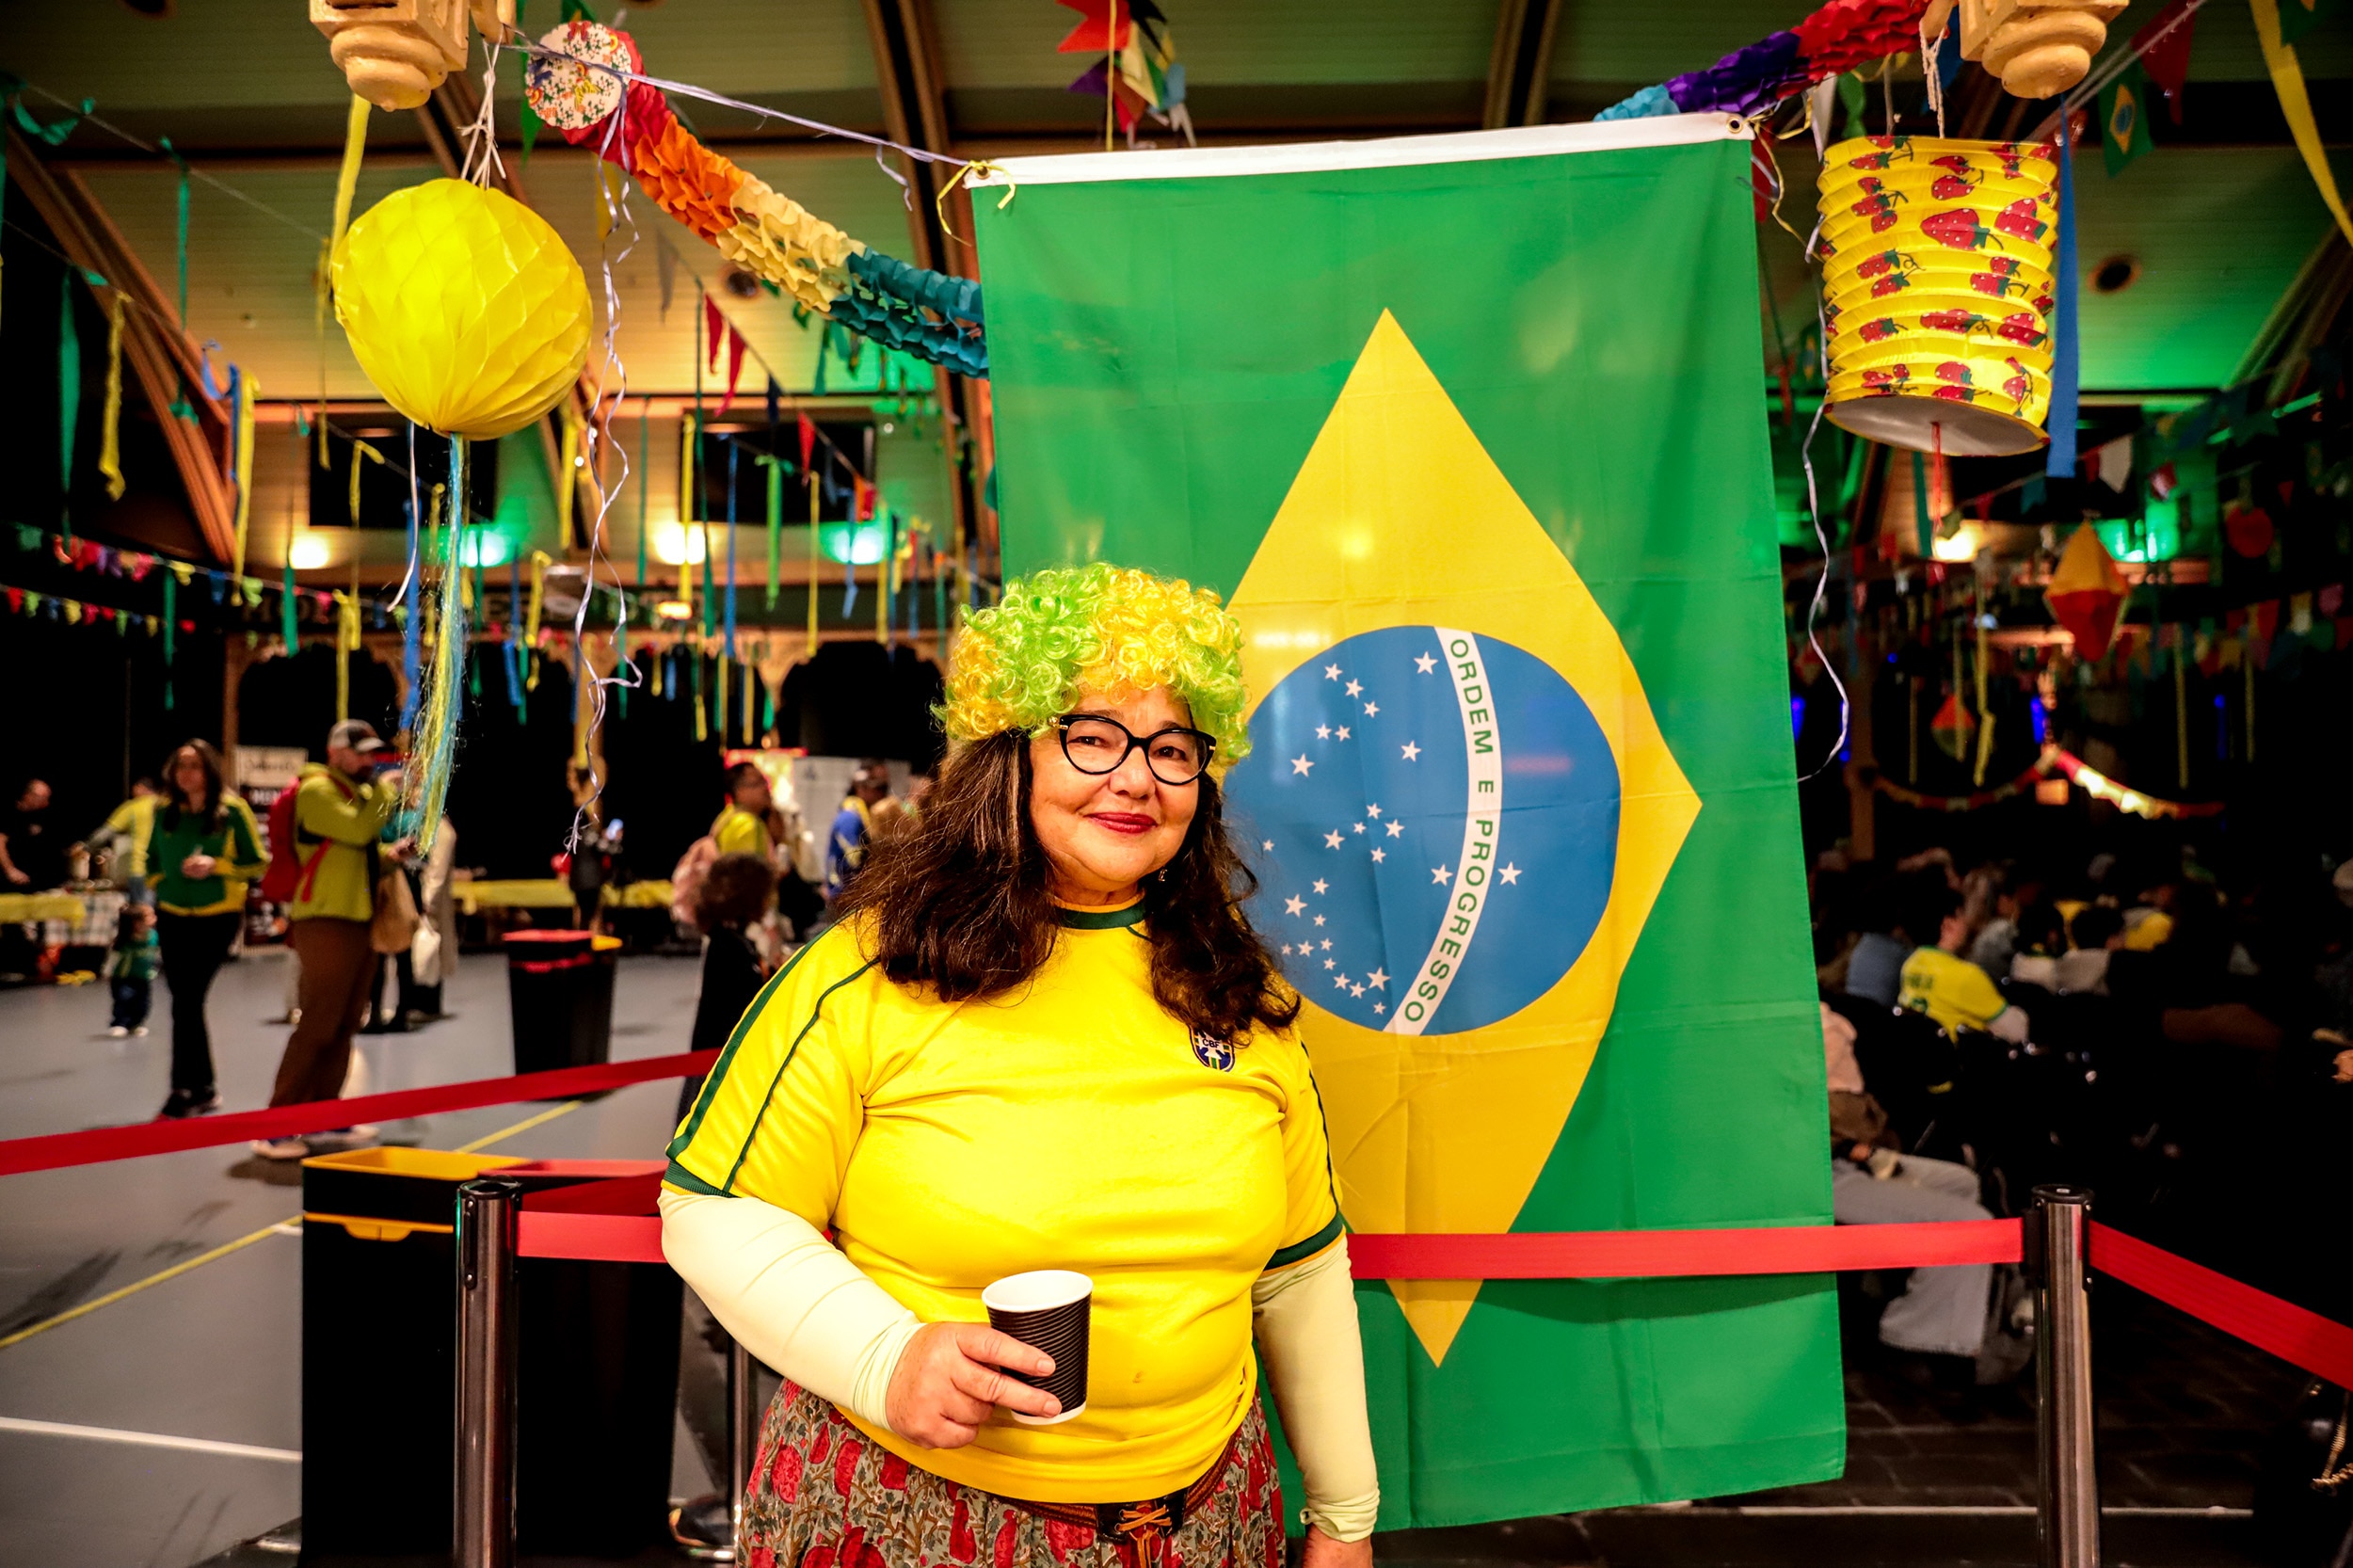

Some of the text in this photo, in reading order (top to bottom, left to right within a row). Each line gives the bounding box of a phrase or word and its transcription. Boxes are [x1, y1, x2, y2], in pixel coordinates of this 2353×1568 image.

[1404, 638, 1494, 1023] ORDEM E PROGRESSO
[1202, 1038, 1220, 1048] CBF
